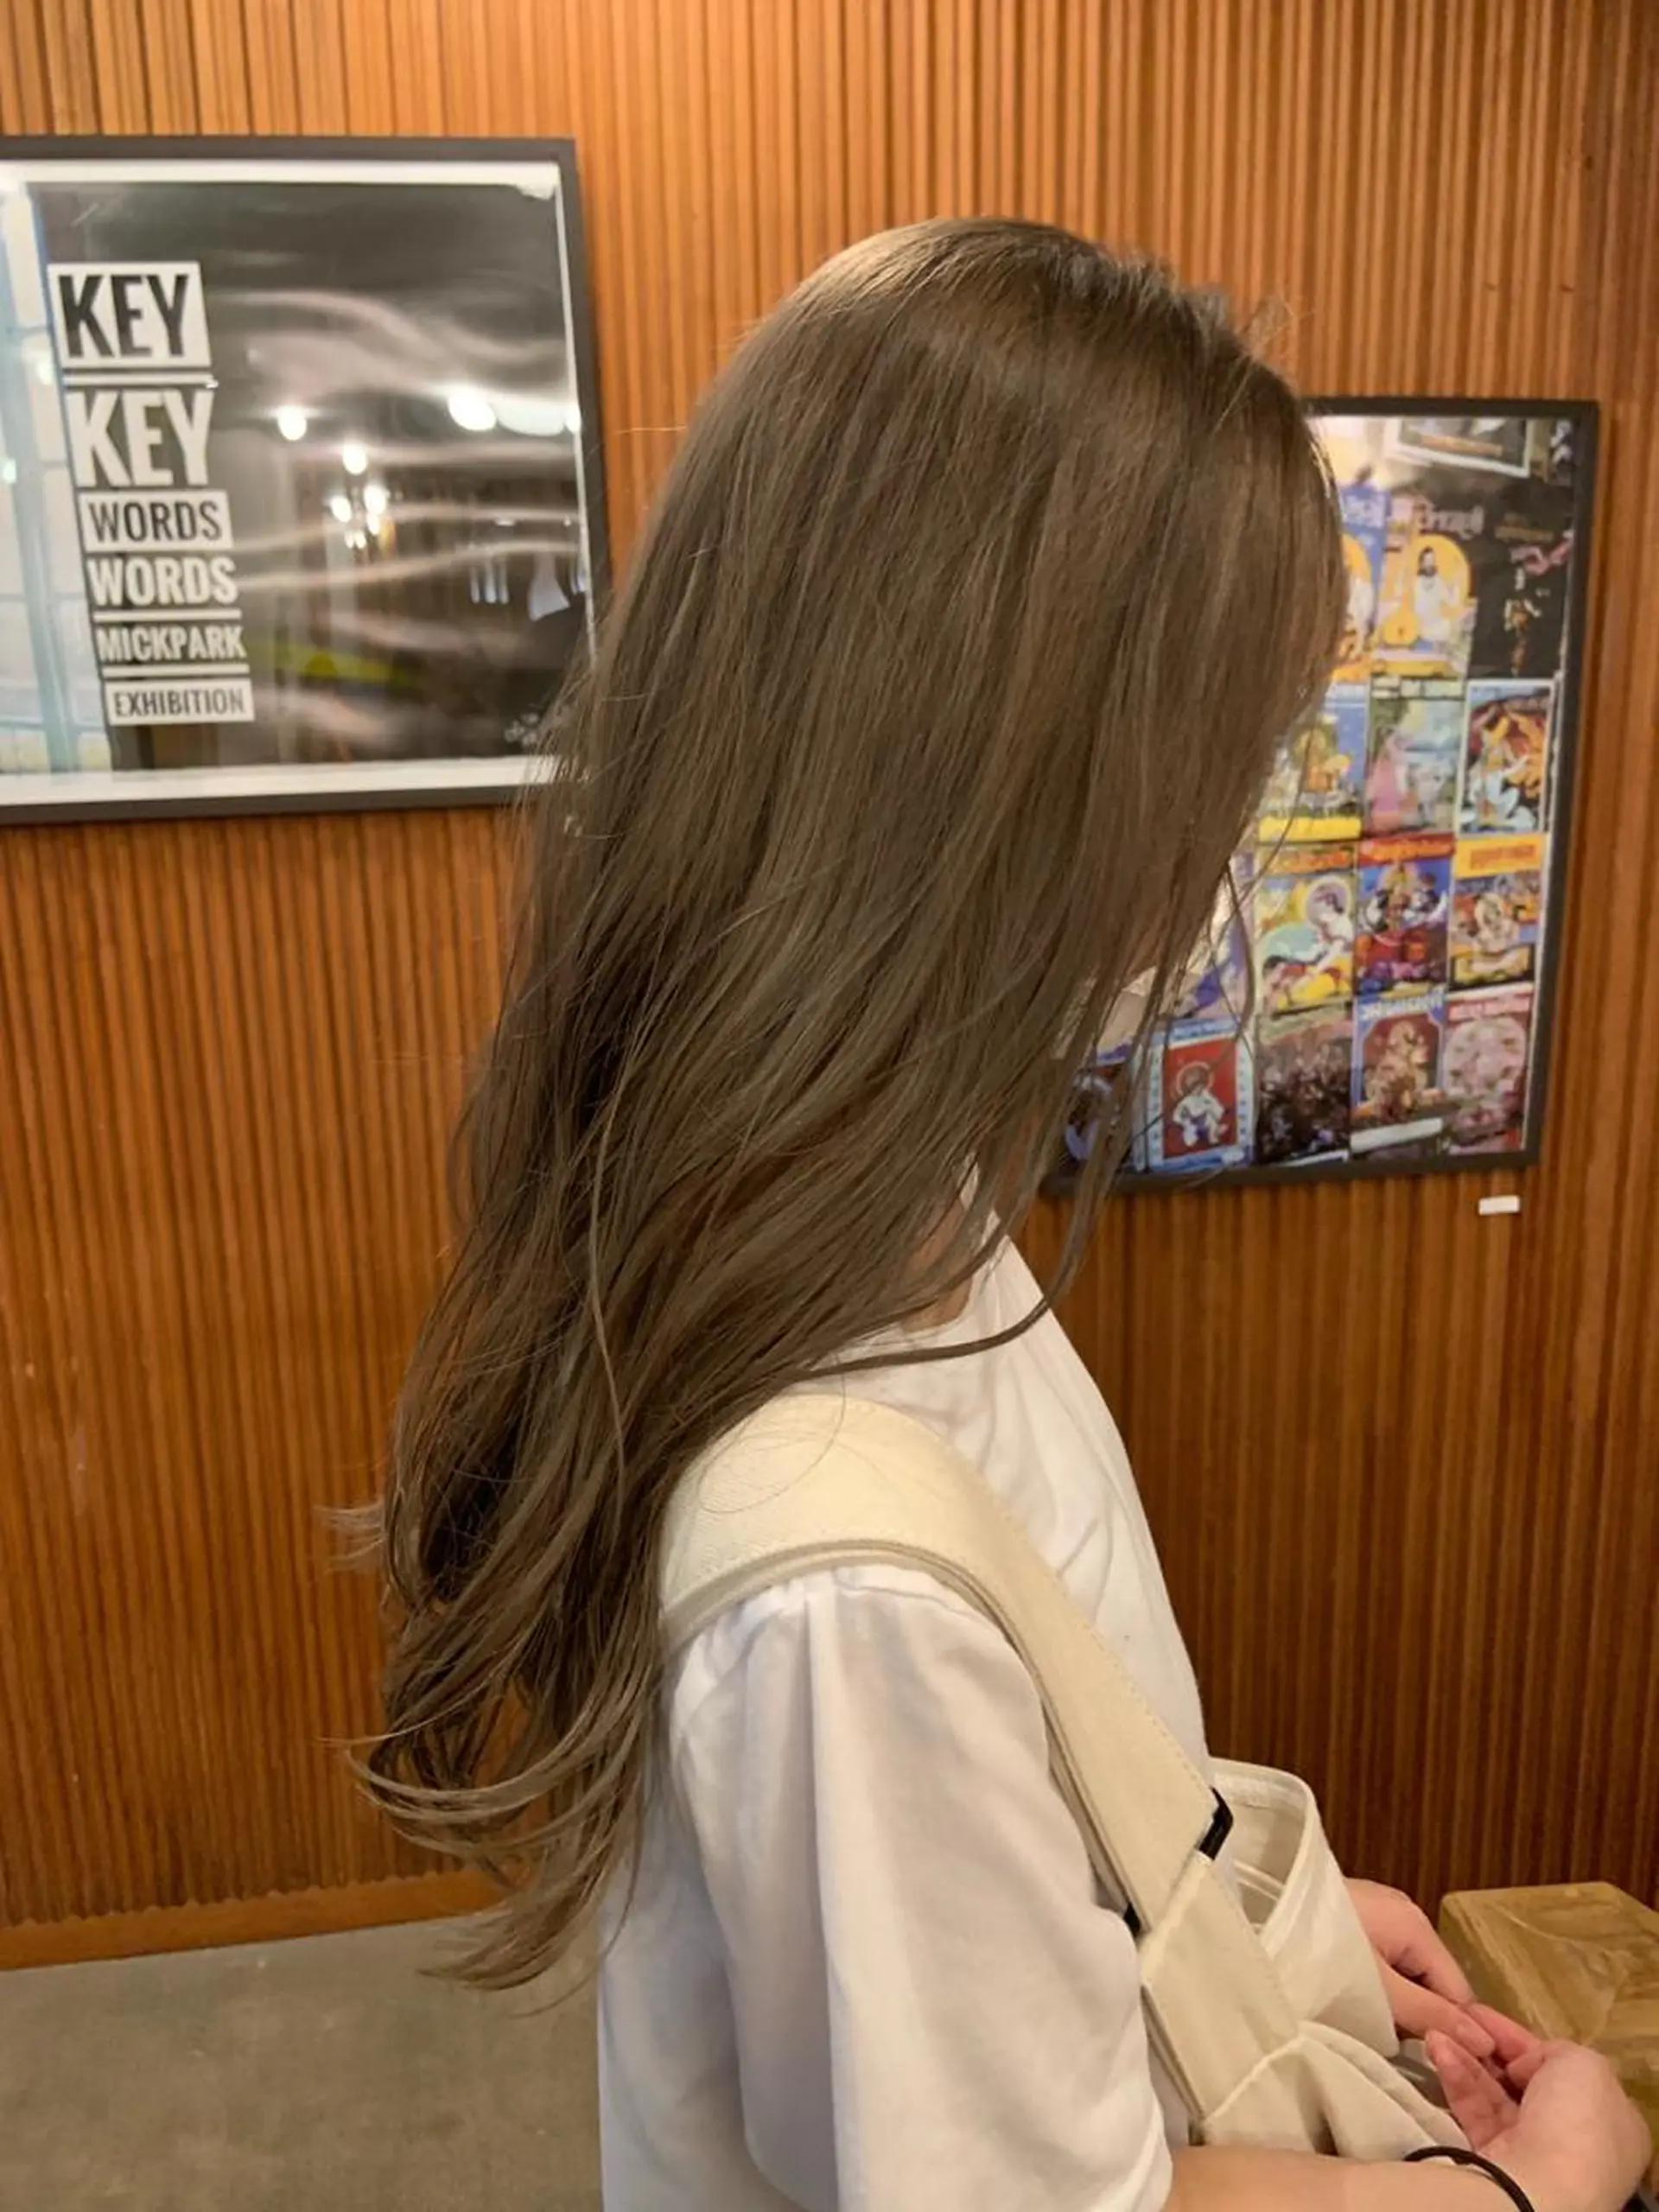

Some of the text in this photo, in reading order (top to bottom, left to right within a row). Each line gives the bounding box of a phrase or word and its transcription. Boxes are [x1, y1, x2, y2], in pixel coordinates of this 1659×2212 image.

[59, 274, 188, 358] KEY
[65, 391, 215, 486] KEY
[89, 501, 222, 543] WORDS
[88, 557, 238, 606] WORDS
[97, 626, 246, 662] MICKPARK
[113, 689, 245, 718] EXHIBITION
